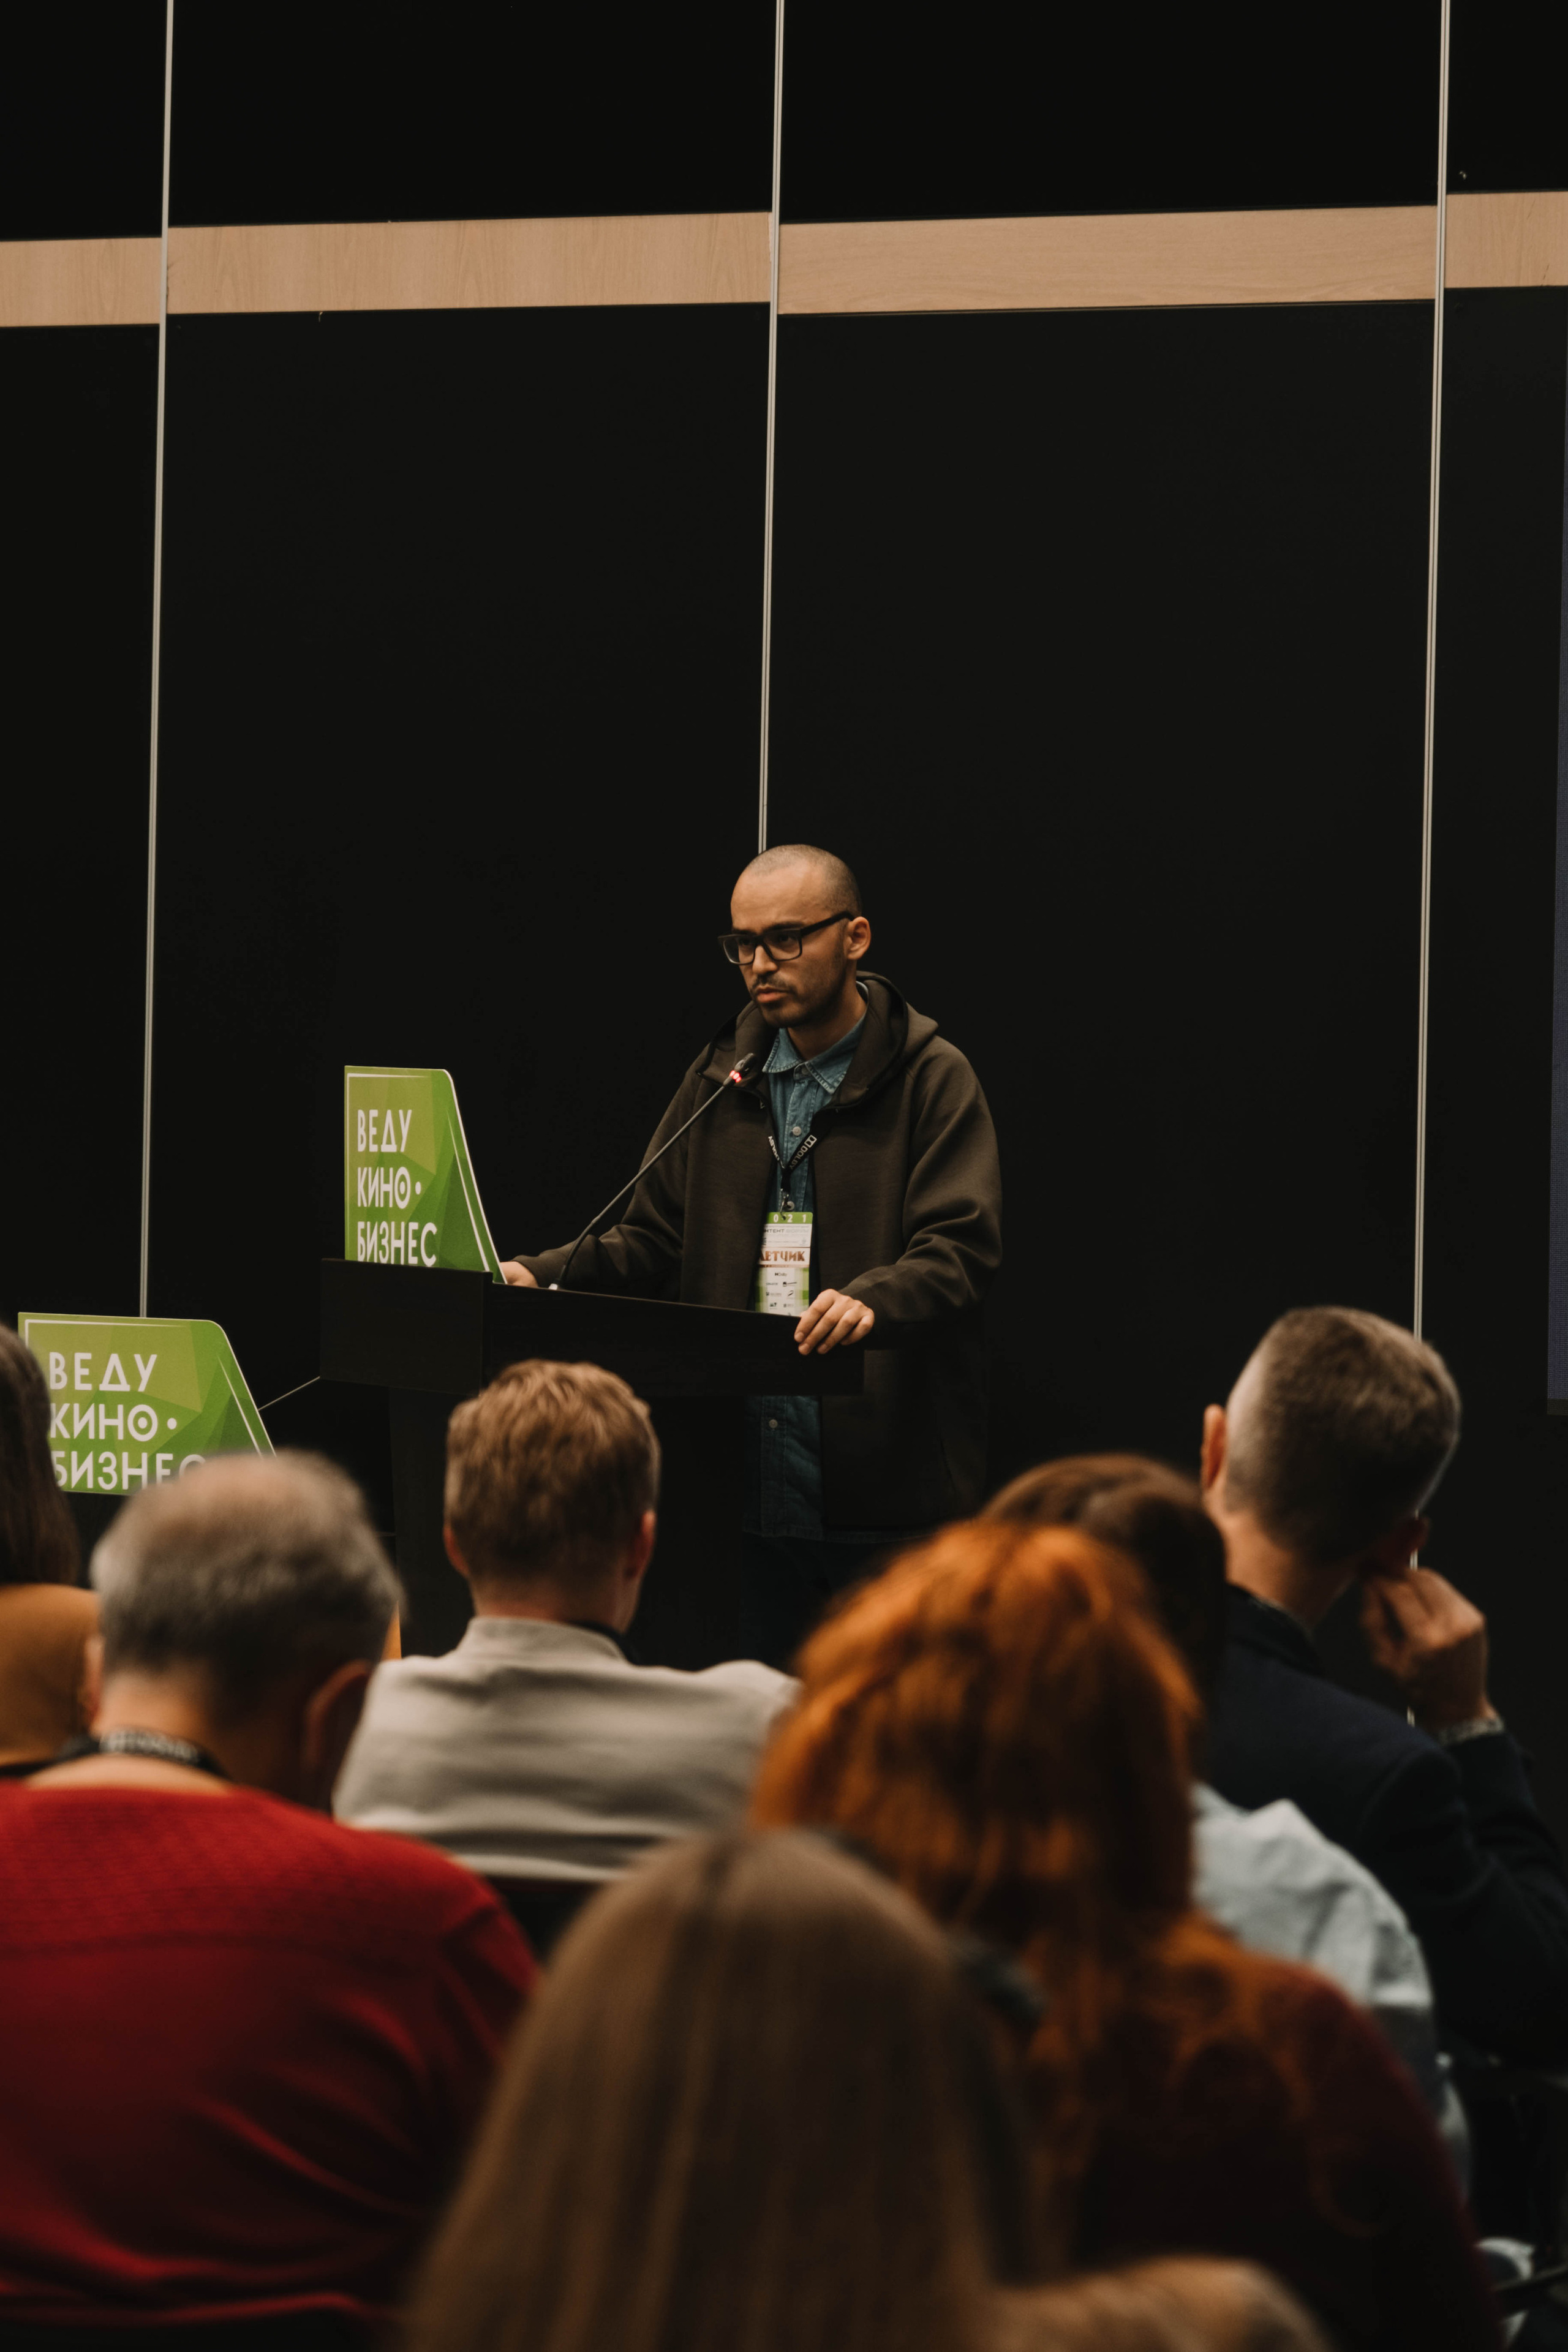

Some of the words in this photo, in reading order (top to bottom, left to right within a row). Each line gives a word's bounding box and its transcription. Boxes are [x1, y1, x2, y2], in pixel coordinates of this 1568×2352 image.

[357, 1109, 412, 1152] ВЕДУ
[789, 1145, 809, 1169] DOLBY
[357, 1221, 437, 1267] БИЗНЕС
[49, 1352, 157, 1392] ВЕДУ
